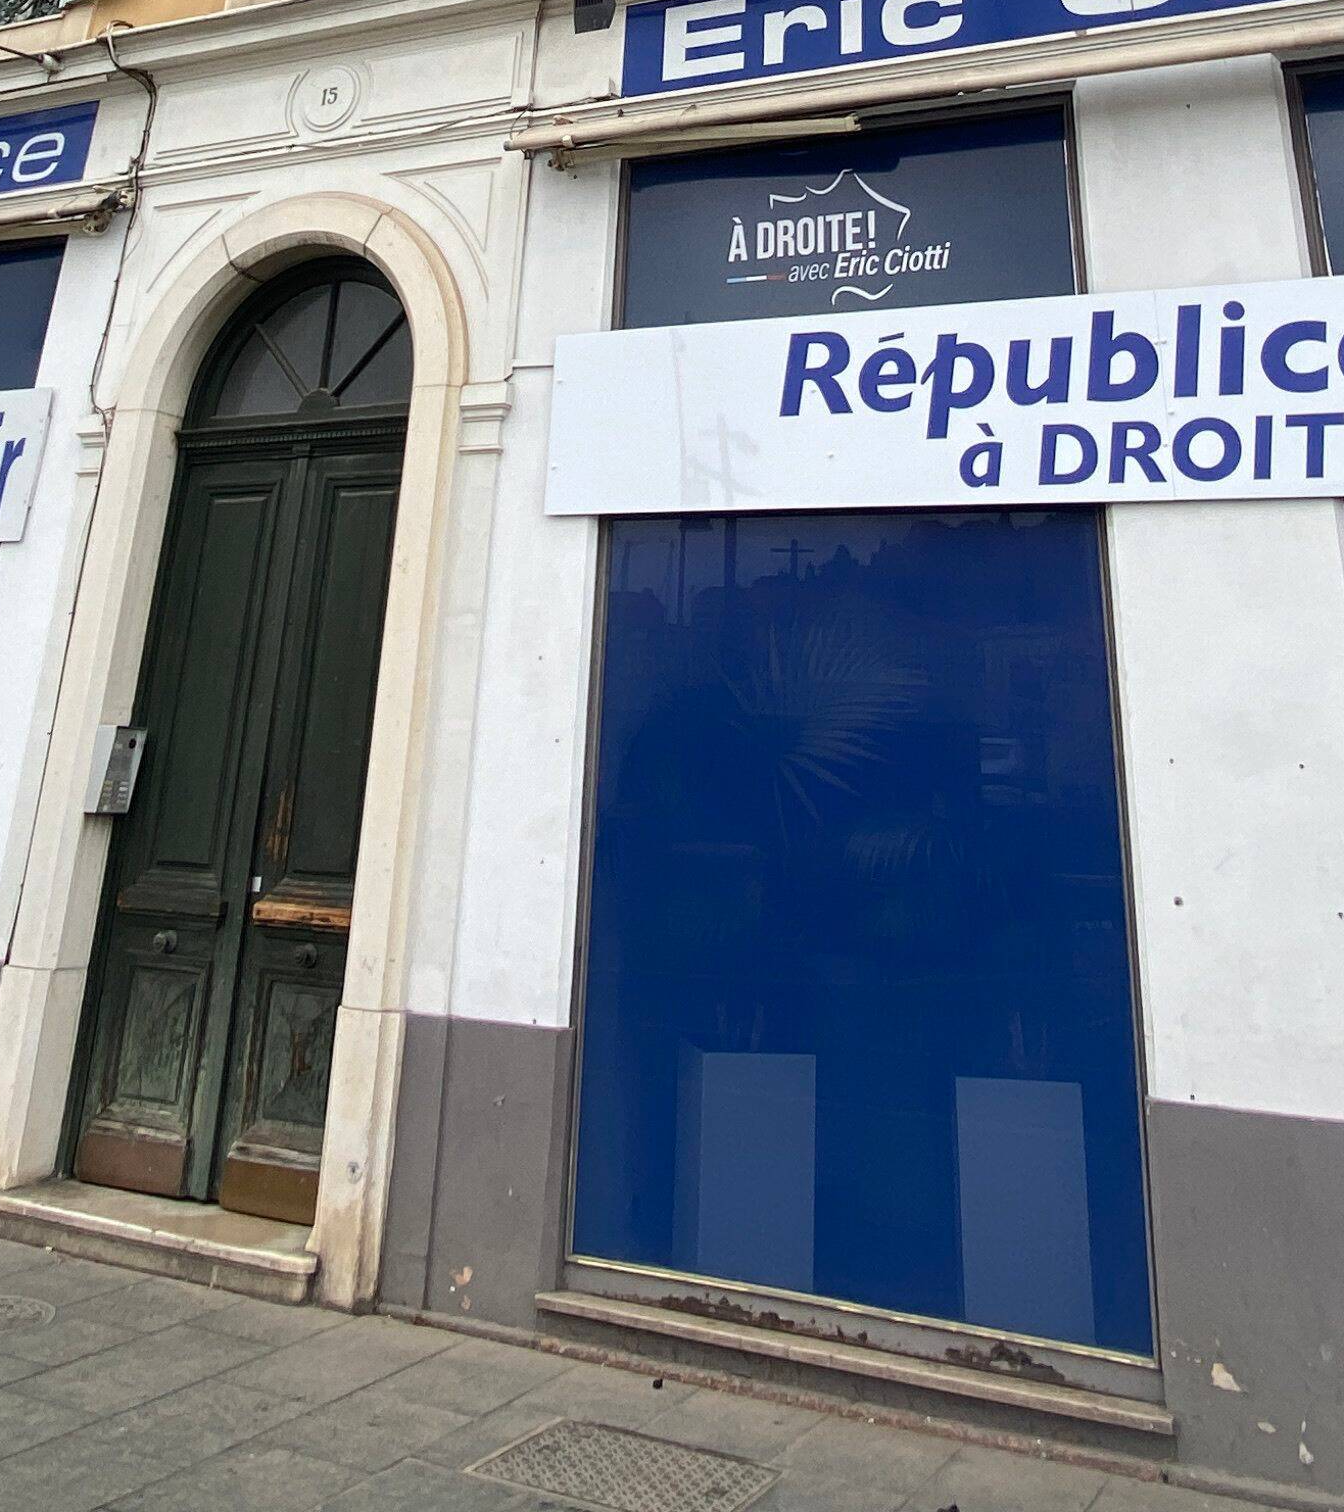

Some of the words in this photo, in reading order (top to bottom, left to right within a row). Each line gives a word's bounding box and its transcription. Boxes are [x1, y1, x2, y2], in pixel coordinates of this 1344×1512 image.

[320, 86, 338, 106] 15
[727, 217, 749, 263] À
[788, 262, 830, 283] avec
[834, 248, 879, 279] Eric
[884, 241, 951, 276] Ciotti
[959, 408, 1005, 488] à
